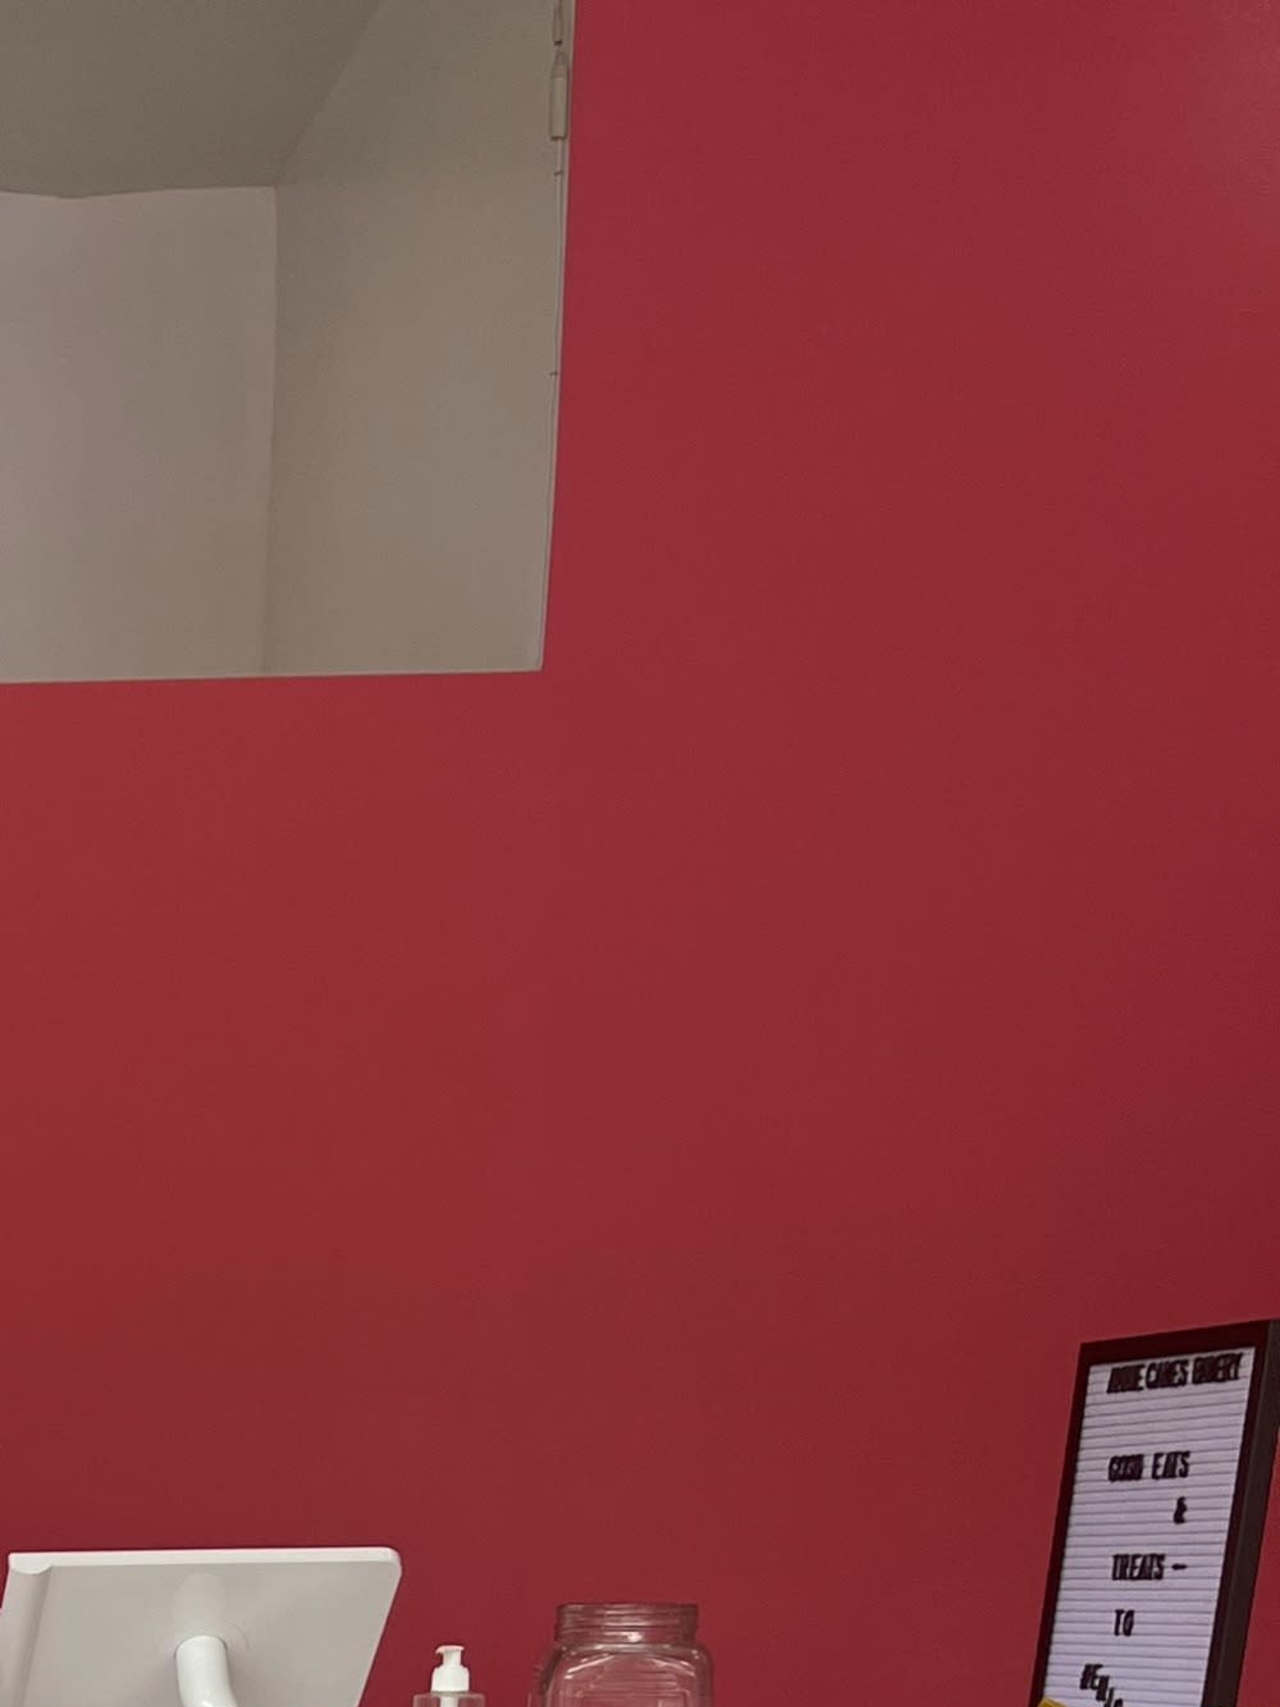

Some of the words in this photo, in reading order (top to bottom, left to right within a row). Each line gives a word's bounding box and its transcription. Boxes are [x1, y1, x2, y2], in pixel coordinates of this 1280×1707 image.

[1151, 1451, 1191, 1480] EATS
[1112, 1554, 1165, 1580] TREATS
[1114, 1609, 1134, 1636] TO
